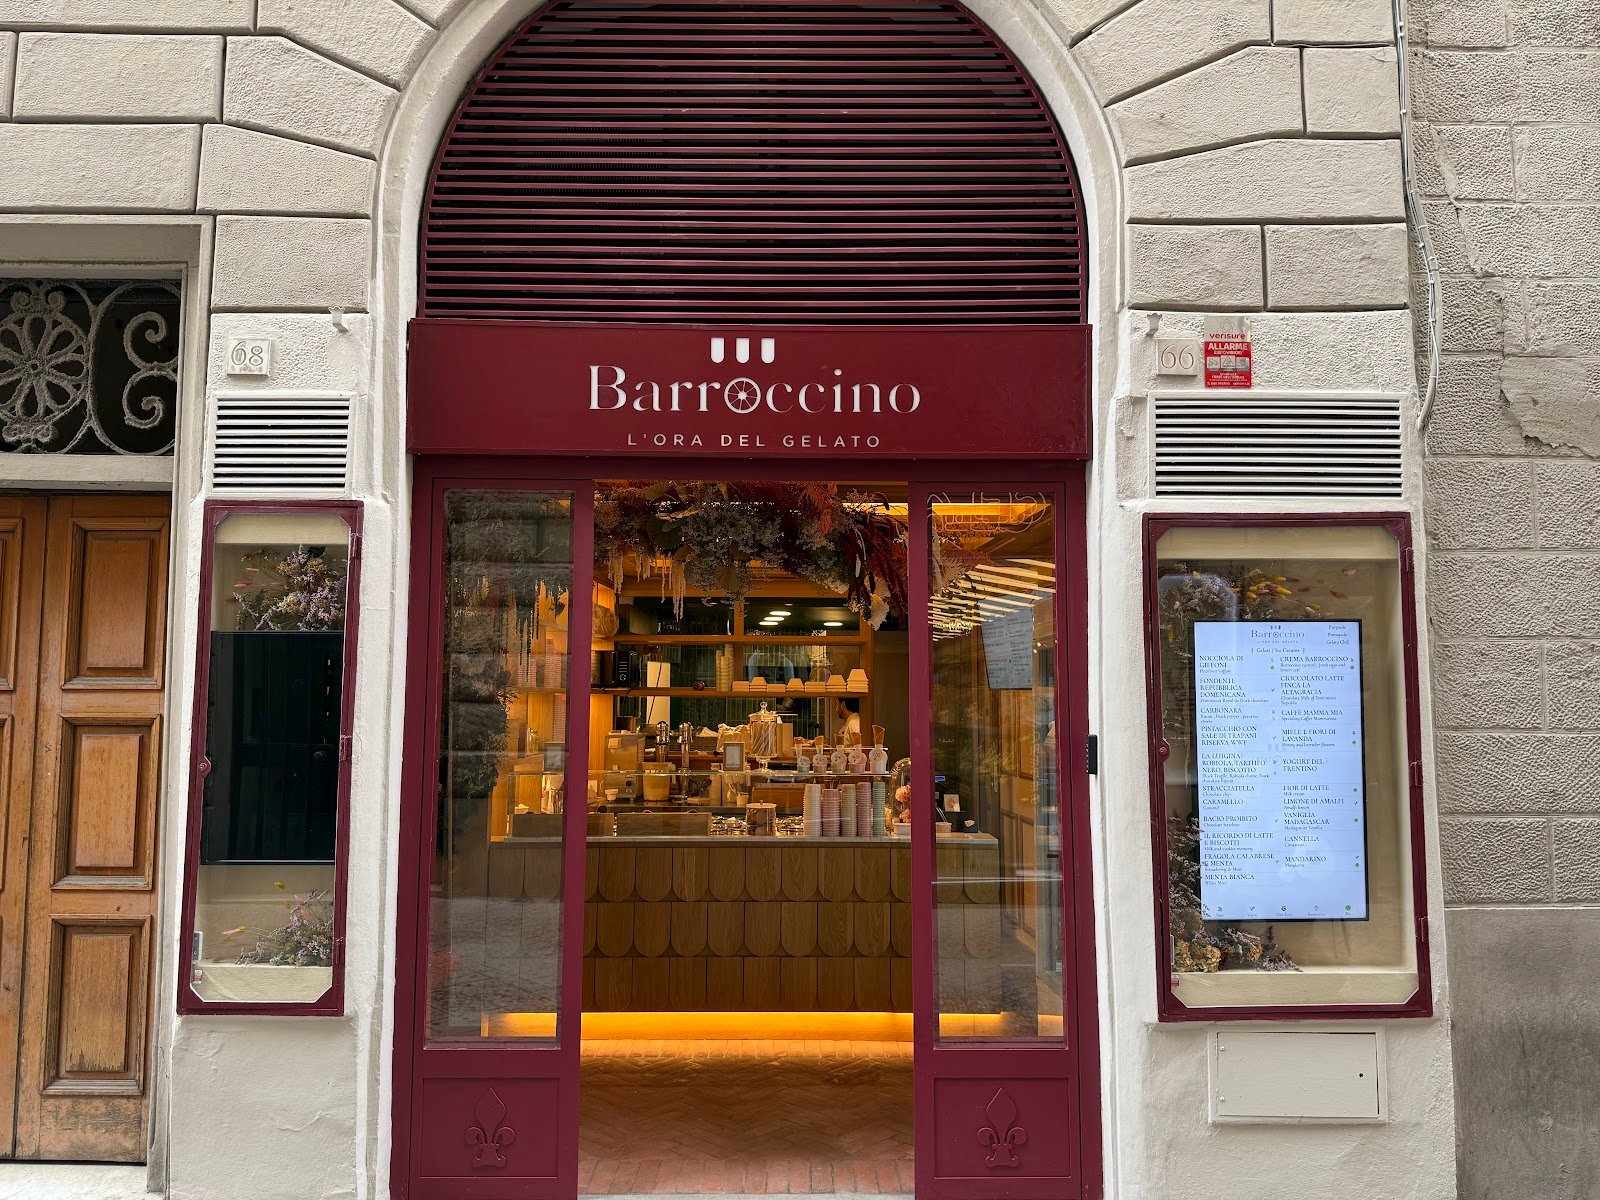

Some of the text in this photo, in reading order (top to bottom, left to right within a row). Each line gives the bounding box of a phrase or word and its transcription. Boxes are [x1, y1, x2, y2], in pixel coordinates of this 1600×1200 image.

[231, 341, 263, 366] 68
[1161, 345, 1194, 369] 66
[588, 365, 921, 414] Barroccino
[628, 433, 880, 448] L'ORA DEL GELATO
[1251, 630, 1305, 638] Barroccino
